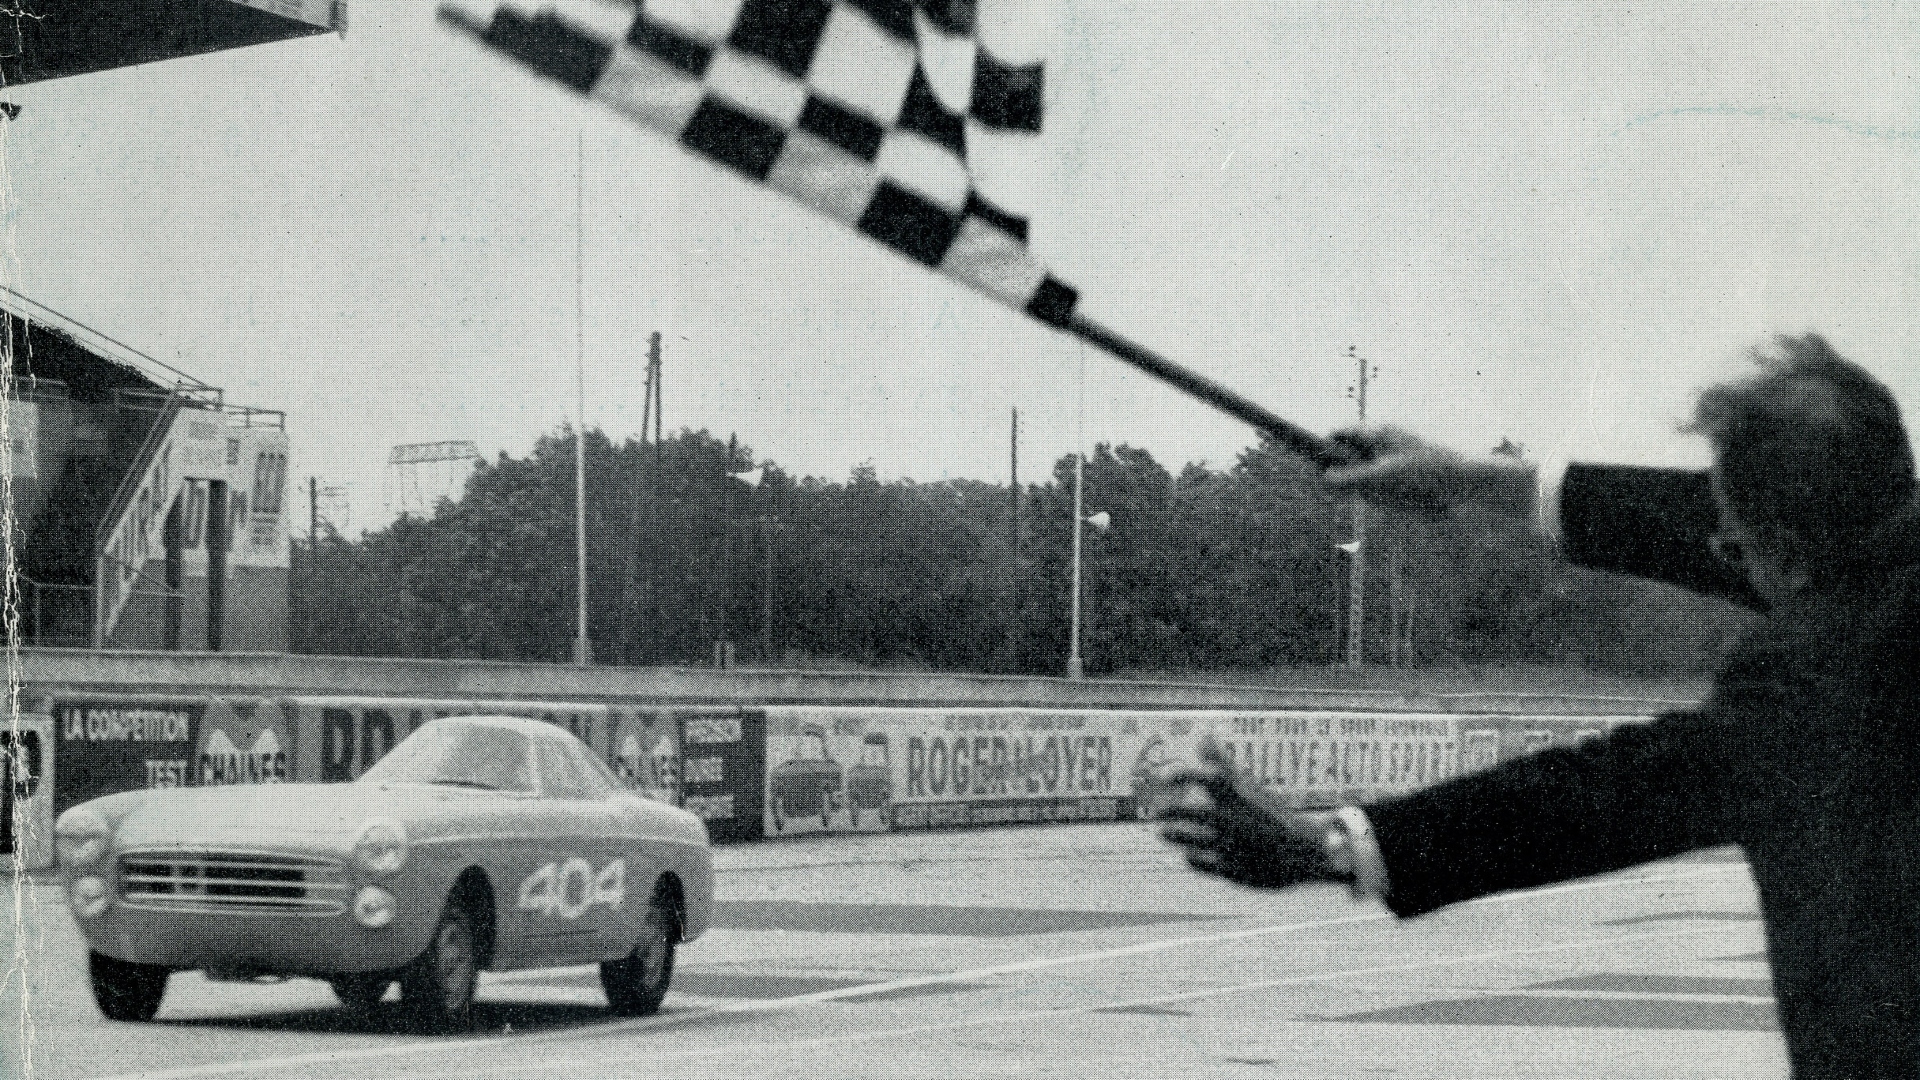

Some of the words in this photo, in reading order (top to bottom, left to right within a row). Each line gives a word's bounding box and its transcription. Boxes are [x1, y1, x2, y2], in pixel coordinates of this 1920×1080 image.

[64, 708, 84, 741] LA
[145, 759, 187, 789] TEST
[201, 752, 286, 786] CHAINES
[907, 736, 1008, 797] ROGER
[517, 857, 625, 919] 404
